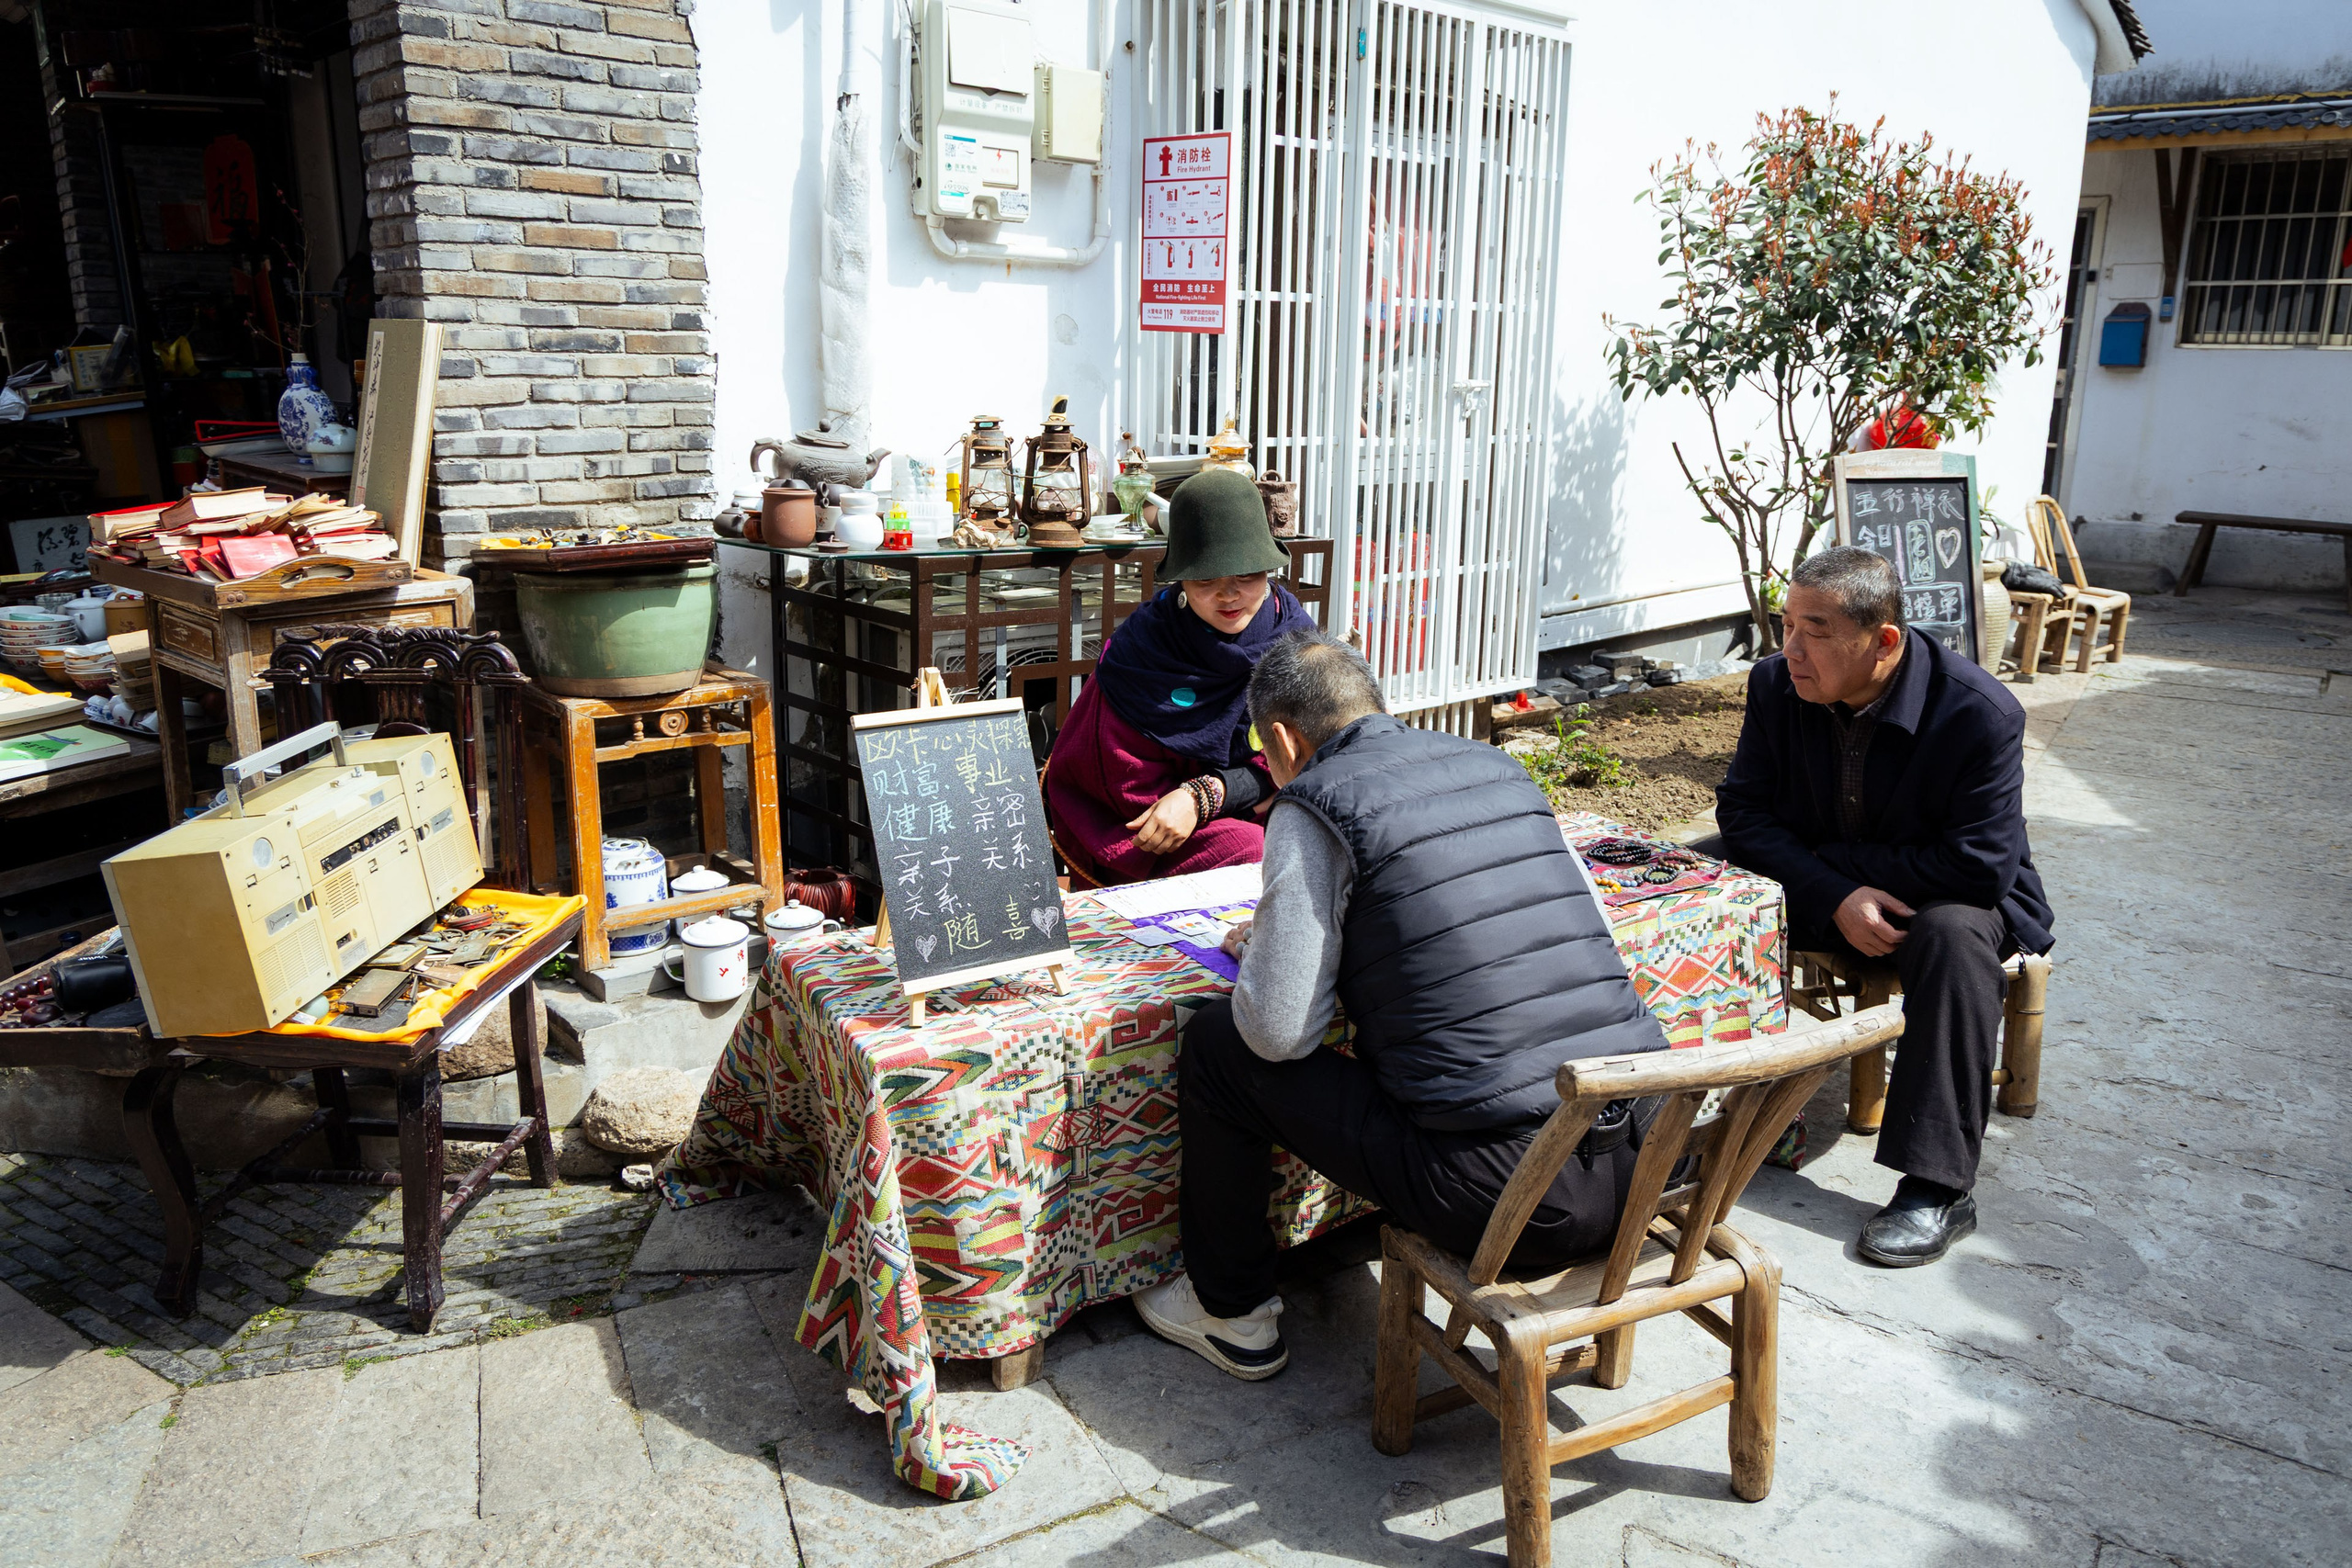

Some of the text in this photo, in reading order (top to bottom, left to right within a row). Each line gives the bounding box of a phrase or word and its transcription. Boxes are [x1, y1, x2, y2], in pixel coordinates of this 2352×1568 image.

[1177, 147, 1211, 164] 消防栓
[1189, 165, 1211, 174] Hydrant
[212, 160, 249, 219] 福
[1153, 283, 1216, 294] 全民消防 生命至上
[1164, 309, 1173, 320] 119
[865, 716, 1032, 765] 欧卡心灵探索
